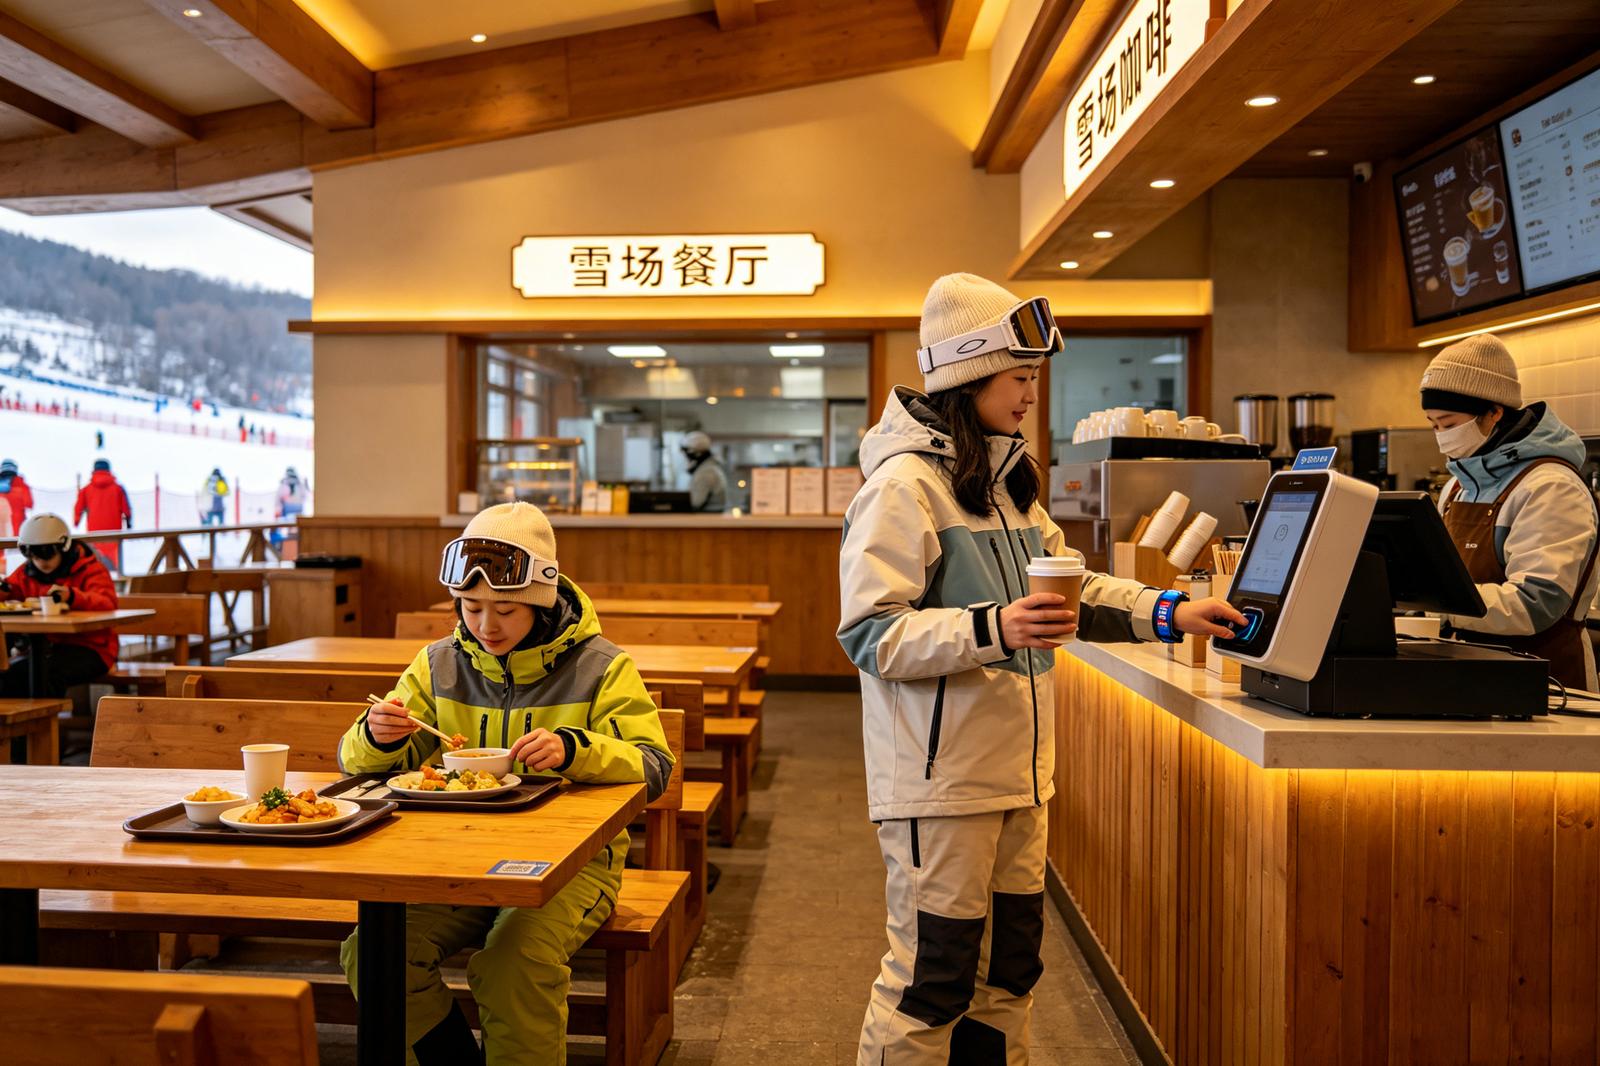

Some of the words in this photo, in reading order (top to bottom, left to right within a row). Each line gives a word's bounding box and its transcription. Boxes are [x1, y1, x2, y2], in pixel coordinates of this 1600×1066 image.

[1077, 0, 1172, 170] 雪场咖啡
[570, 243, 768, 287] 雪场餐厅
